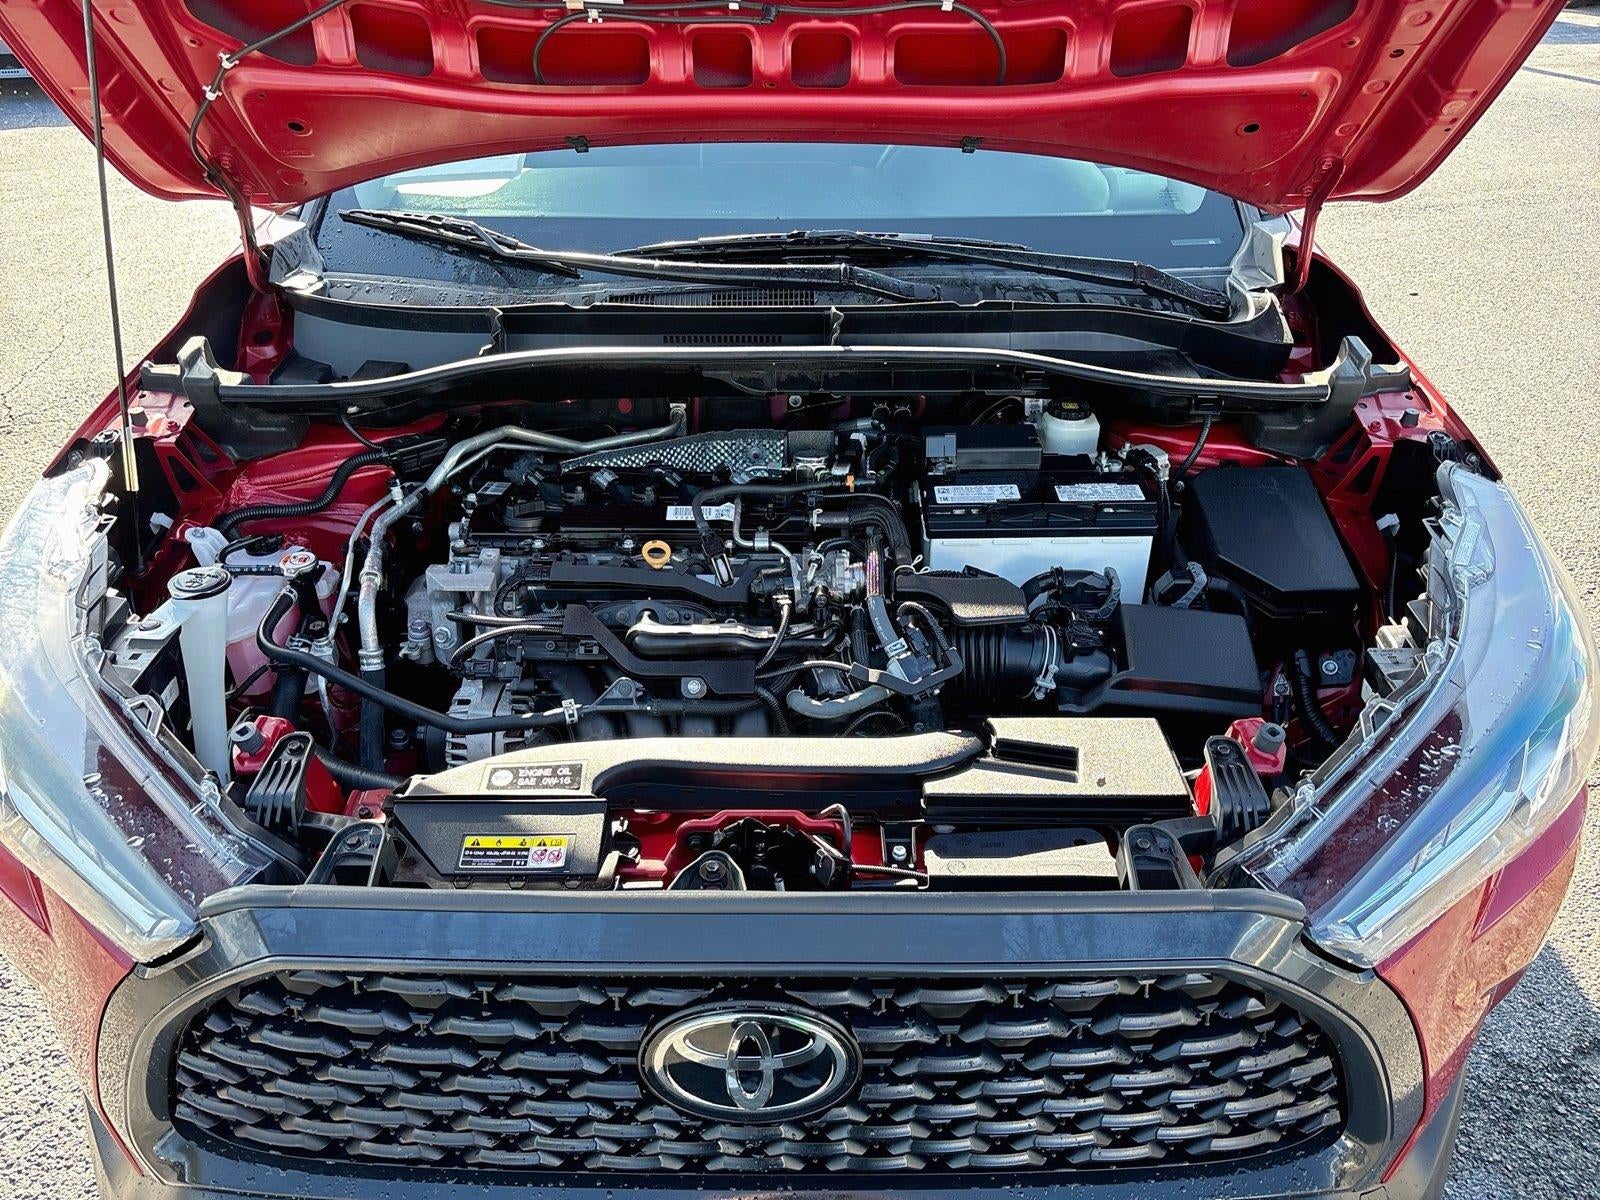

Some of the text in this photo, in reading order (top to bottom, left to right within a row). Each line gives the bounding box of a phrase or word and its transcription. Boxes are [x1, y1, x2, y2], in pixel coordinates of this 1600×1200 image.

[519, 768, 552, 776] ENGINE
[556, 767, 571, 775] OIL
[518, 776, 571, 785] SAE 0W-16
